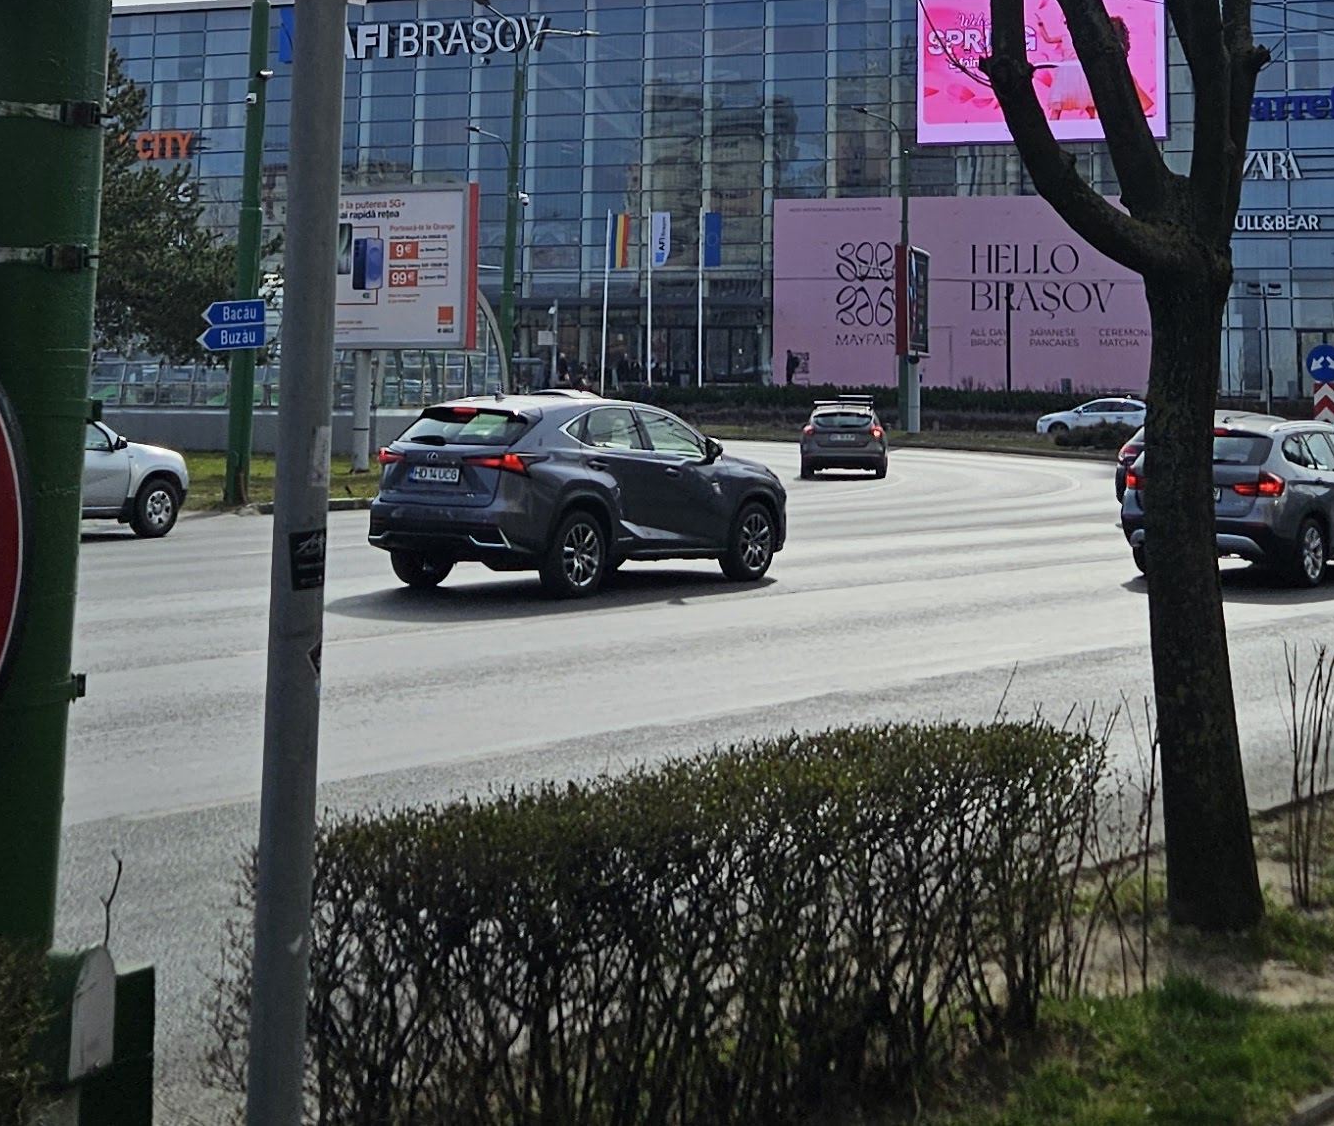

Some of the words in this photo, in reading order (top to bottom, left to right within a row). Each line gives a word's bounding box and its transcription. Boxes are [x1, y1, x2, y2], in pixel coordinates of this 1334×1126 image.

[398, 14, 547, 65] BRAȘOV
[135, 130, 195, 160] CITY
[1242, 150, 1305, 180] ZARA
[971, 244, 1080, 274] HELLO
[971, 281, 1115, 320] BRAȘOV
[223, 305, 257, 321] Bacău
[220, 329, 256, 345] Buzău
[835, 332, 896, 346] MAYFAIR
[971, 329, 987, 337] ALL
[1029, 328, 1076, 337] JAPANESE
[1029, 338, 1079, 347] PANCAKES
[1099, 338, 1140, 347] MATCHA
[415, 466, 428, 478] HD
